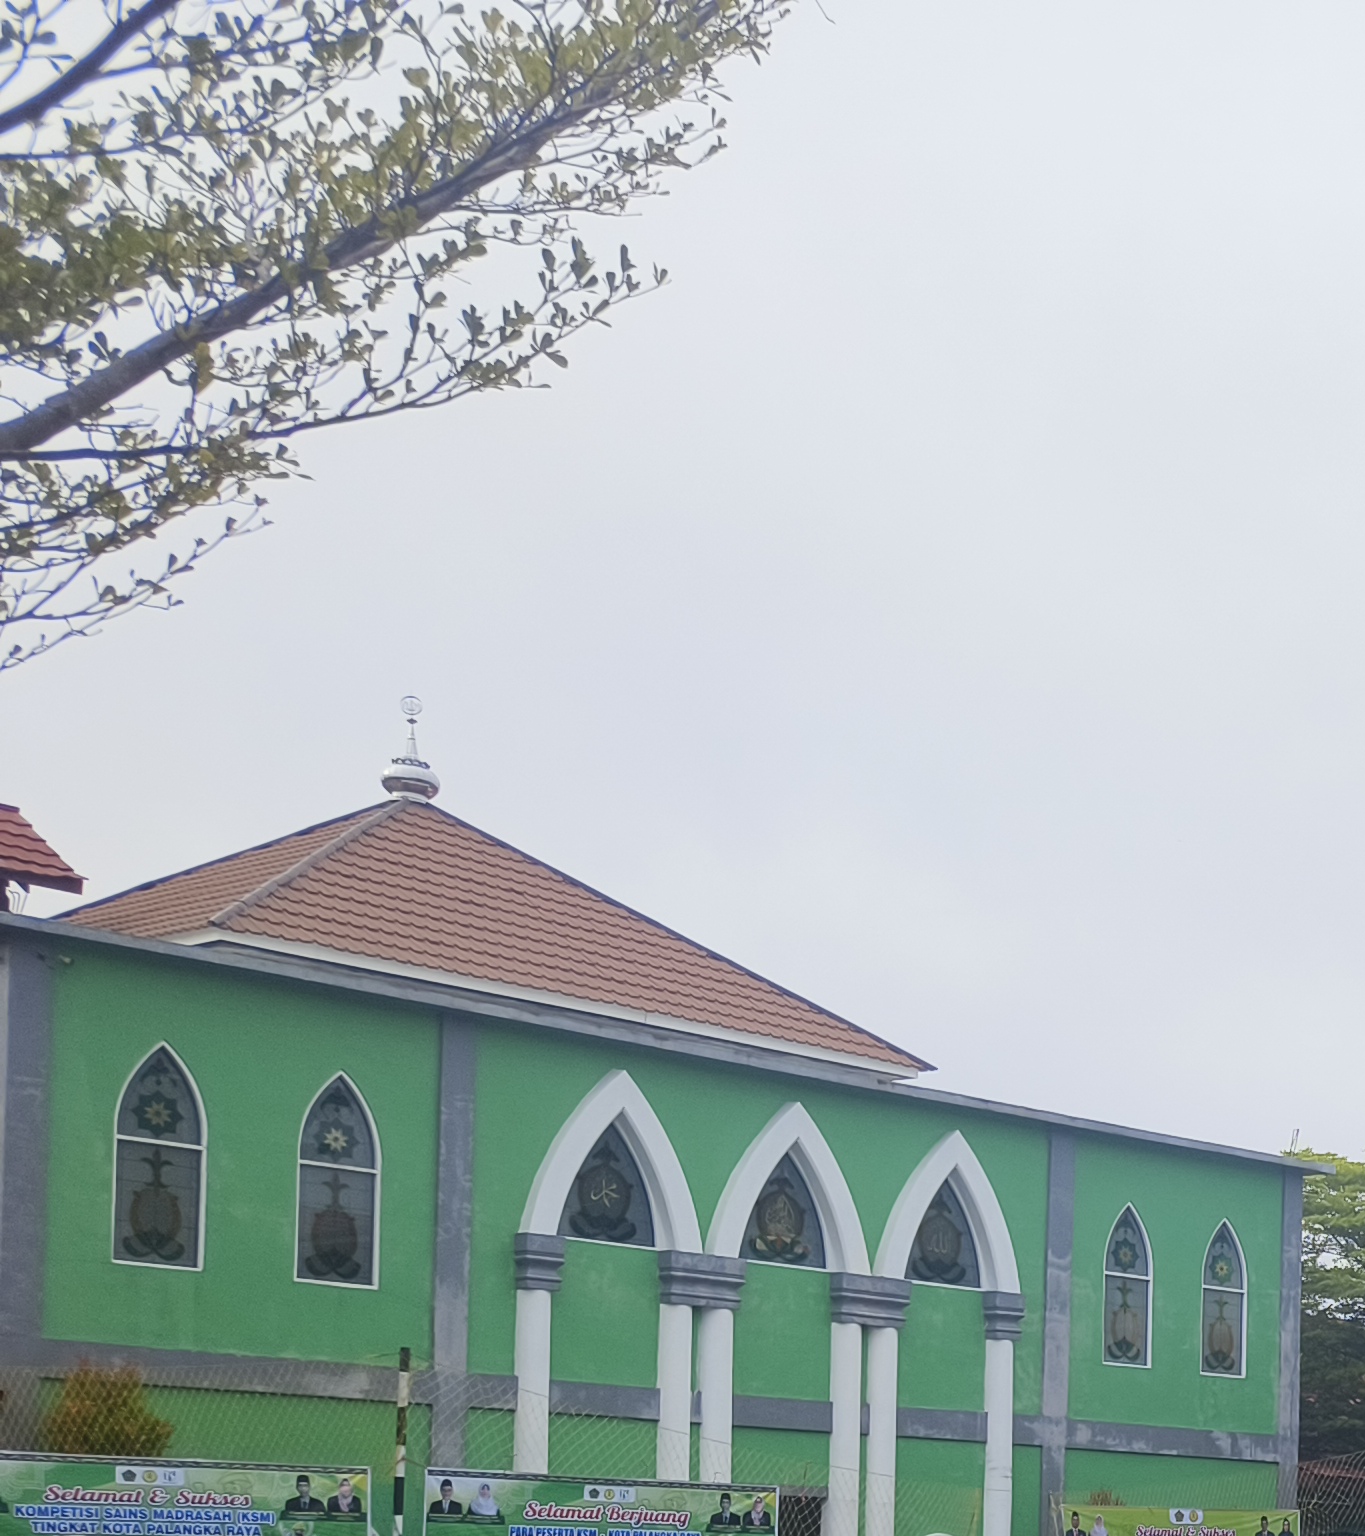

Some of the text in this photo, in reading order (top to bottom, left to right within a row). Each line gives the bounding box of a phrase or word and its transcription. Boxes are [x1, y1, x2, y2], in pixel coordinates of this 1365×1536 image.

[44, 1485, 250, 1507] Selamat & Sukses
[15, 1505, 99, 1518] KOMPETISI
[104, 1507, 148, 1520] SAINS
[153, 1509, 232, 1521] MADRASAH
[237, 1511, 275, 1525] (KSM)
[524, 1502, 603, 1519] Selamat
[606, 1505, 689, 1528] Berjuang
[31, 1521, 262, 1536] TINGKAT KOTA PALANGKA RAYA
[1186, 1526, 1196, 1536] &
